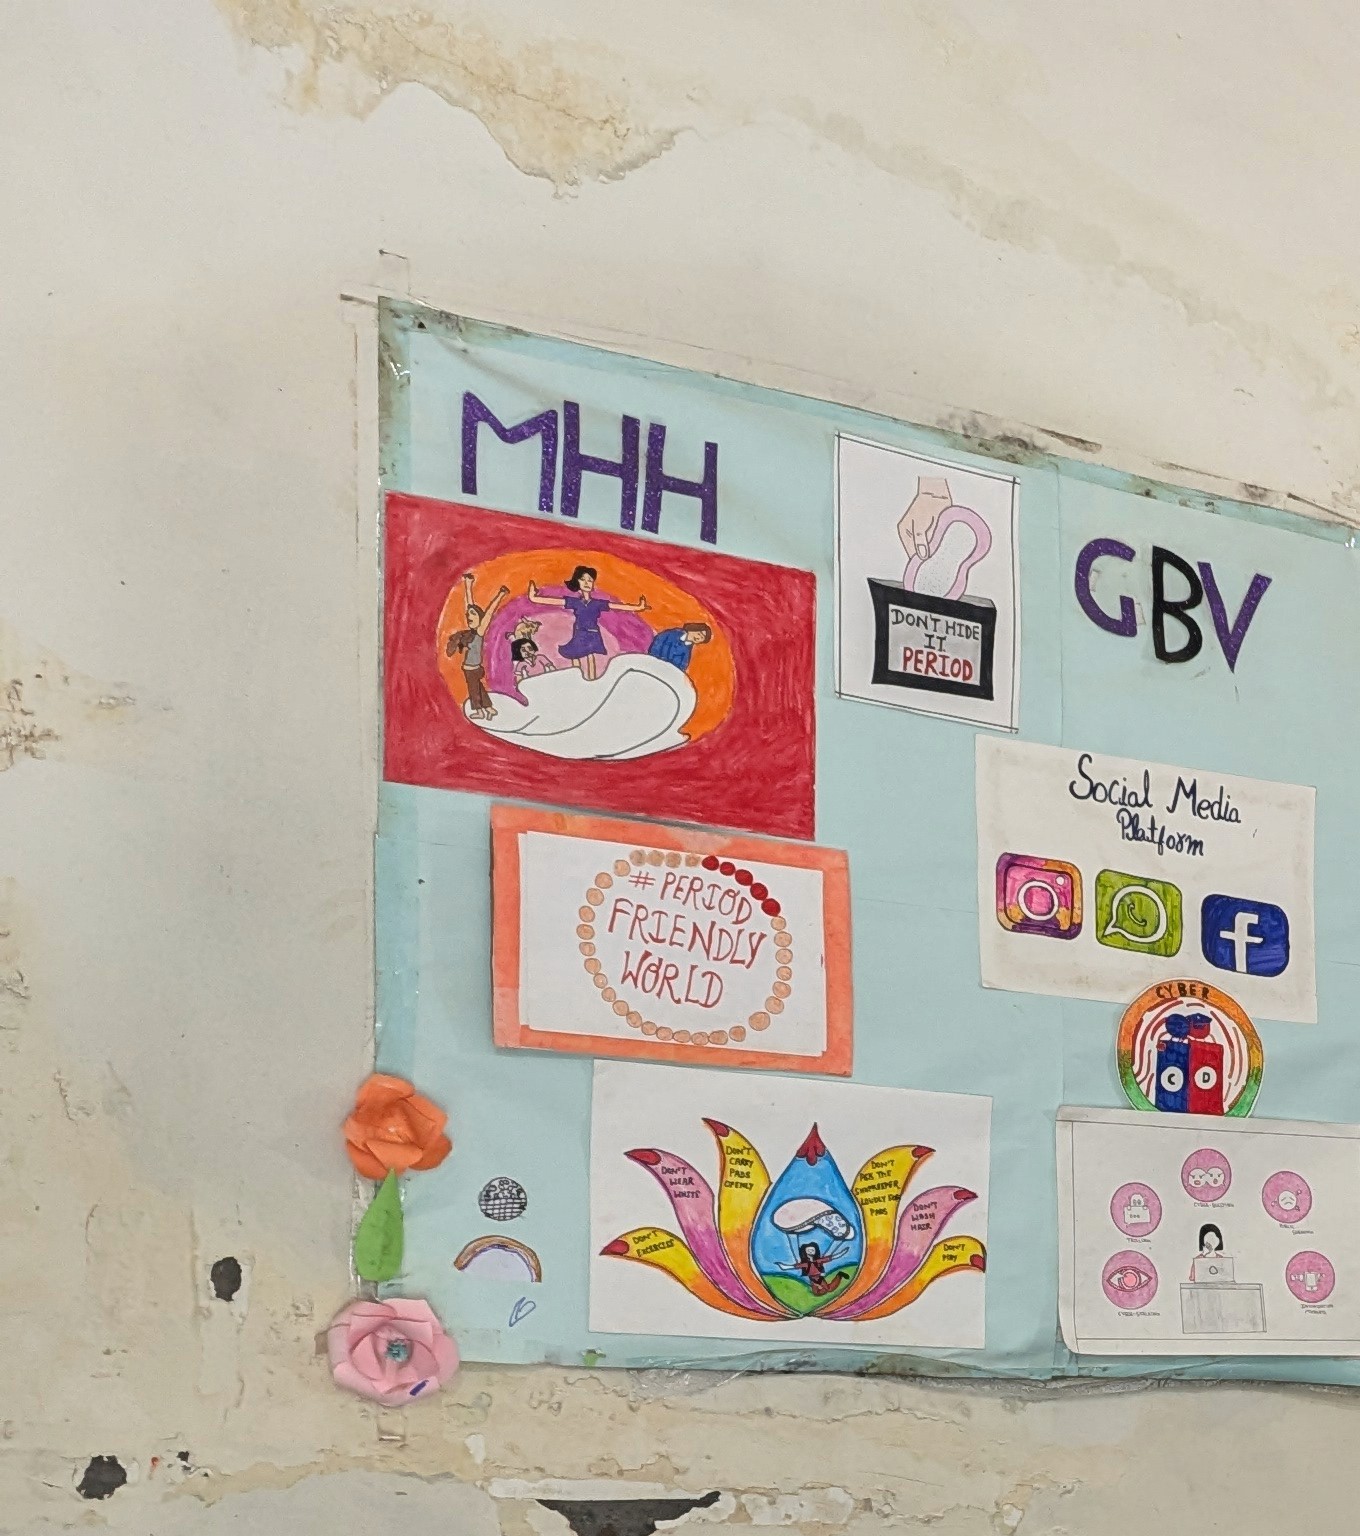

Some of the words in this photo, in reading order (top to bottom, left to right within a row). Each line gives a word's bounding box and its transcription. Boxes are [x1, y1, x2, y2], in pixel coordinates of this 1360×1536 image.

[462, 391, 718, 544] MHH
[891, 608, 940, 632] DON'T
[945, 617, 980, 641] HIDE
[1074, 537, 1272, 673] GBV
[902, 646, 974, 682] PERIOD
[1068, 754, 1151, 810] Social
[1167, 781, 1242, 824] Media
[1116, 808, 1204, 857] Platform
[608, 898, 768, 970] FRIENDLY
[620, 951, 724, 1009] WORLD
[1156, 982, 1211, 1000] CYBER
[669, 1177, 695, 1186] WEAR
